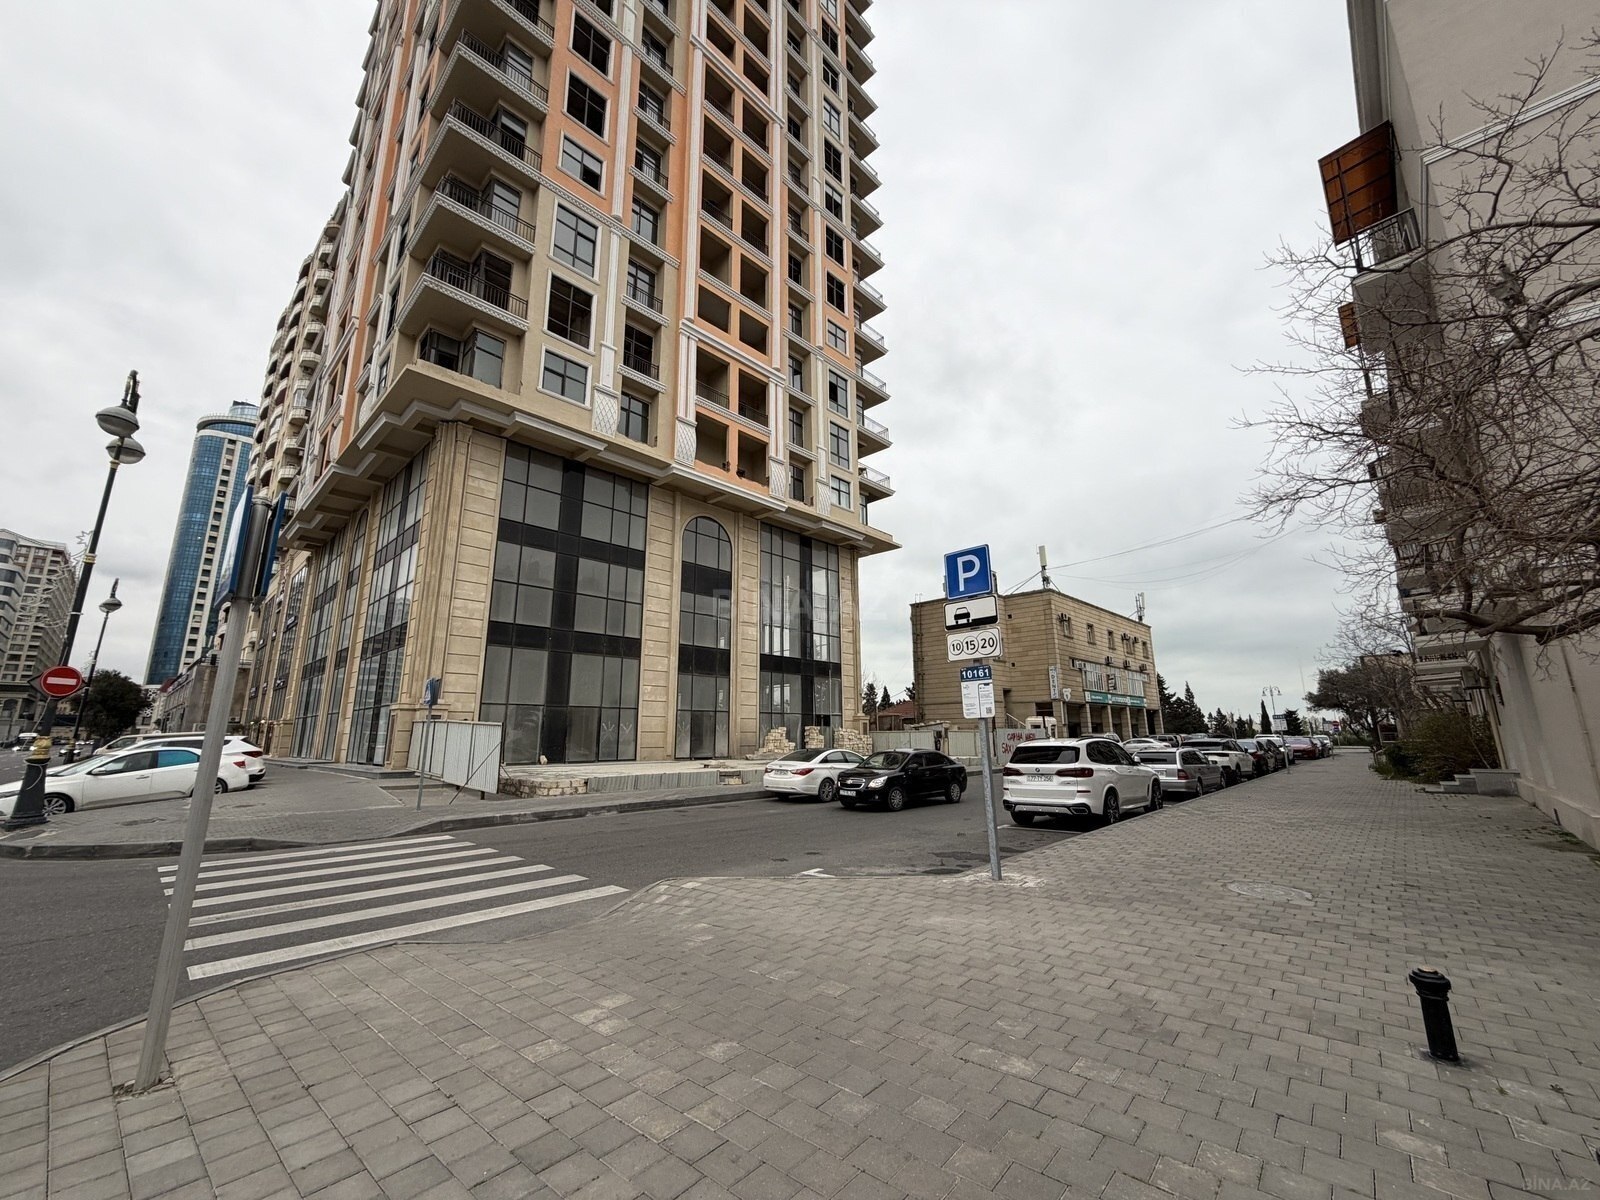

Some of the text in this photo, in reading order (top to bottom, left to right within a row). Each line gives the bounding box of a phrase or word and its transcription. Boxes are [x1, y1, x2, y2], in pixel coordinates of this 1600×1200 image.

[957, 554, 981, 592] P
[952, 637, 995, 652] 10 15 20
[961, 668, 989, 679] 10161
